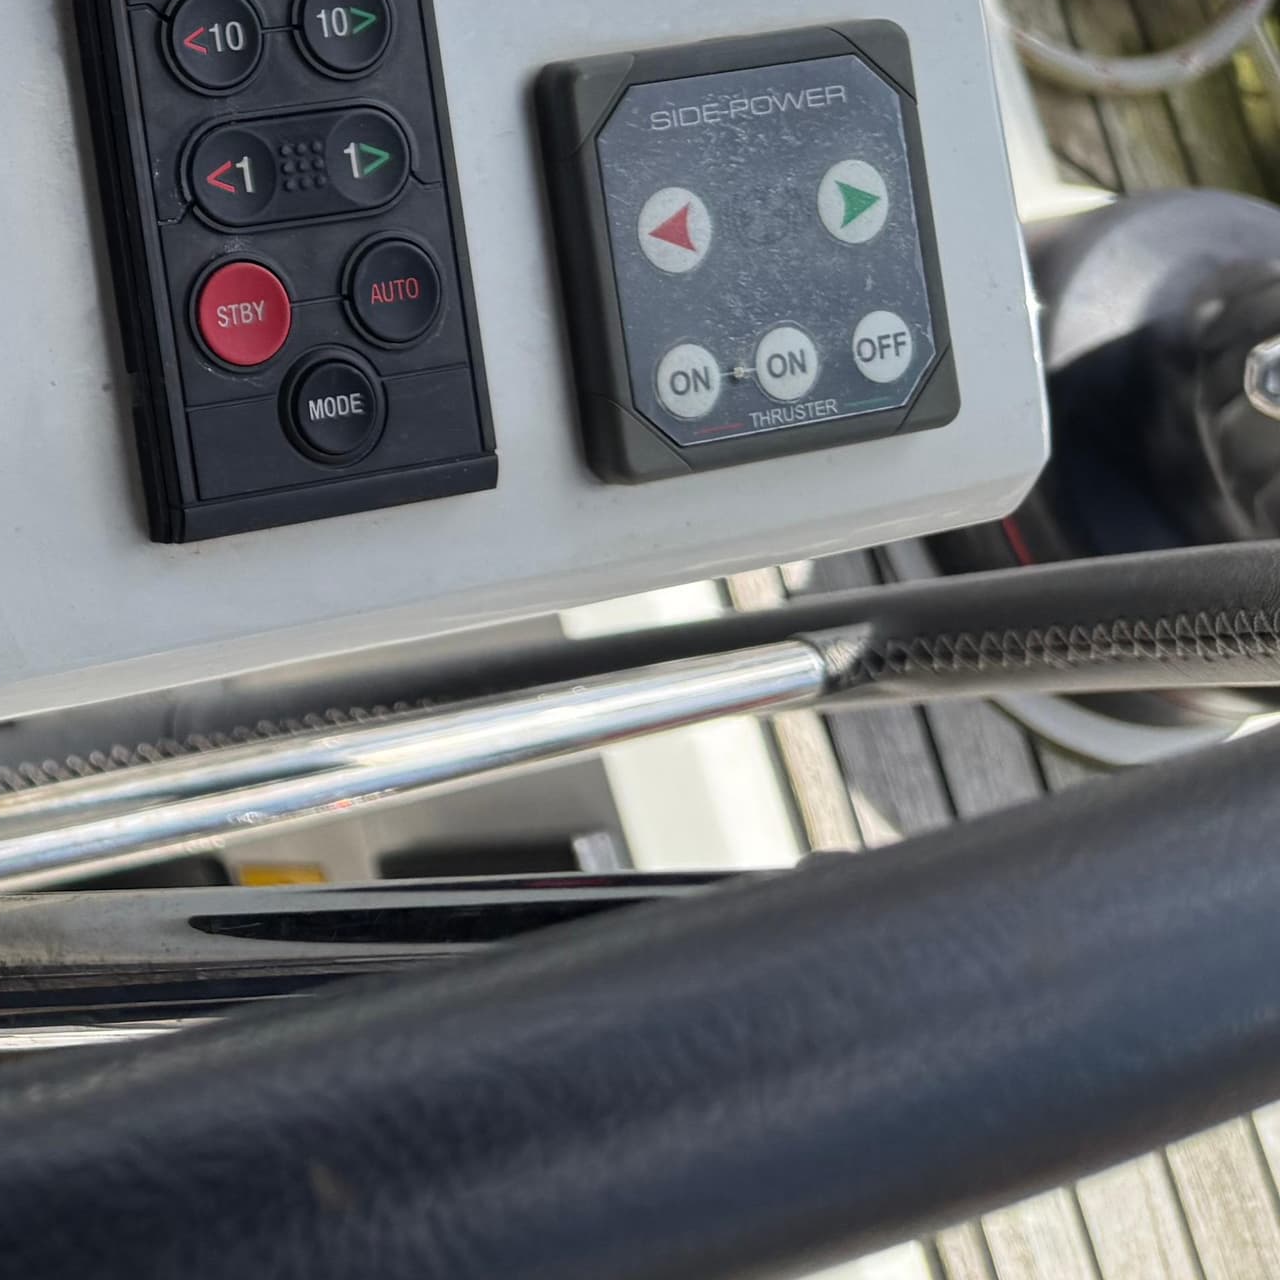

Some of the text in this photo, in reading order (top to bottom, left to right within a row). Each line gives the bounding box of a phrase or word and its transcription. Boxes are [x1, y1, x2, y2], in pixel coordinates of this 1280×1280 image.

[649, 84, 848, 133] SIDE-POWER
[370, 277, 420, 305] AUTO
[216, 300, 266, 328] STBY
[856, 332, 907, 363] OFF
[766, 349, 807, 379] ON
[669, 365, 712, 396] ON
[308, 393, 364, 421] MODE
[748, 398, 838, 428] THRUSTER
